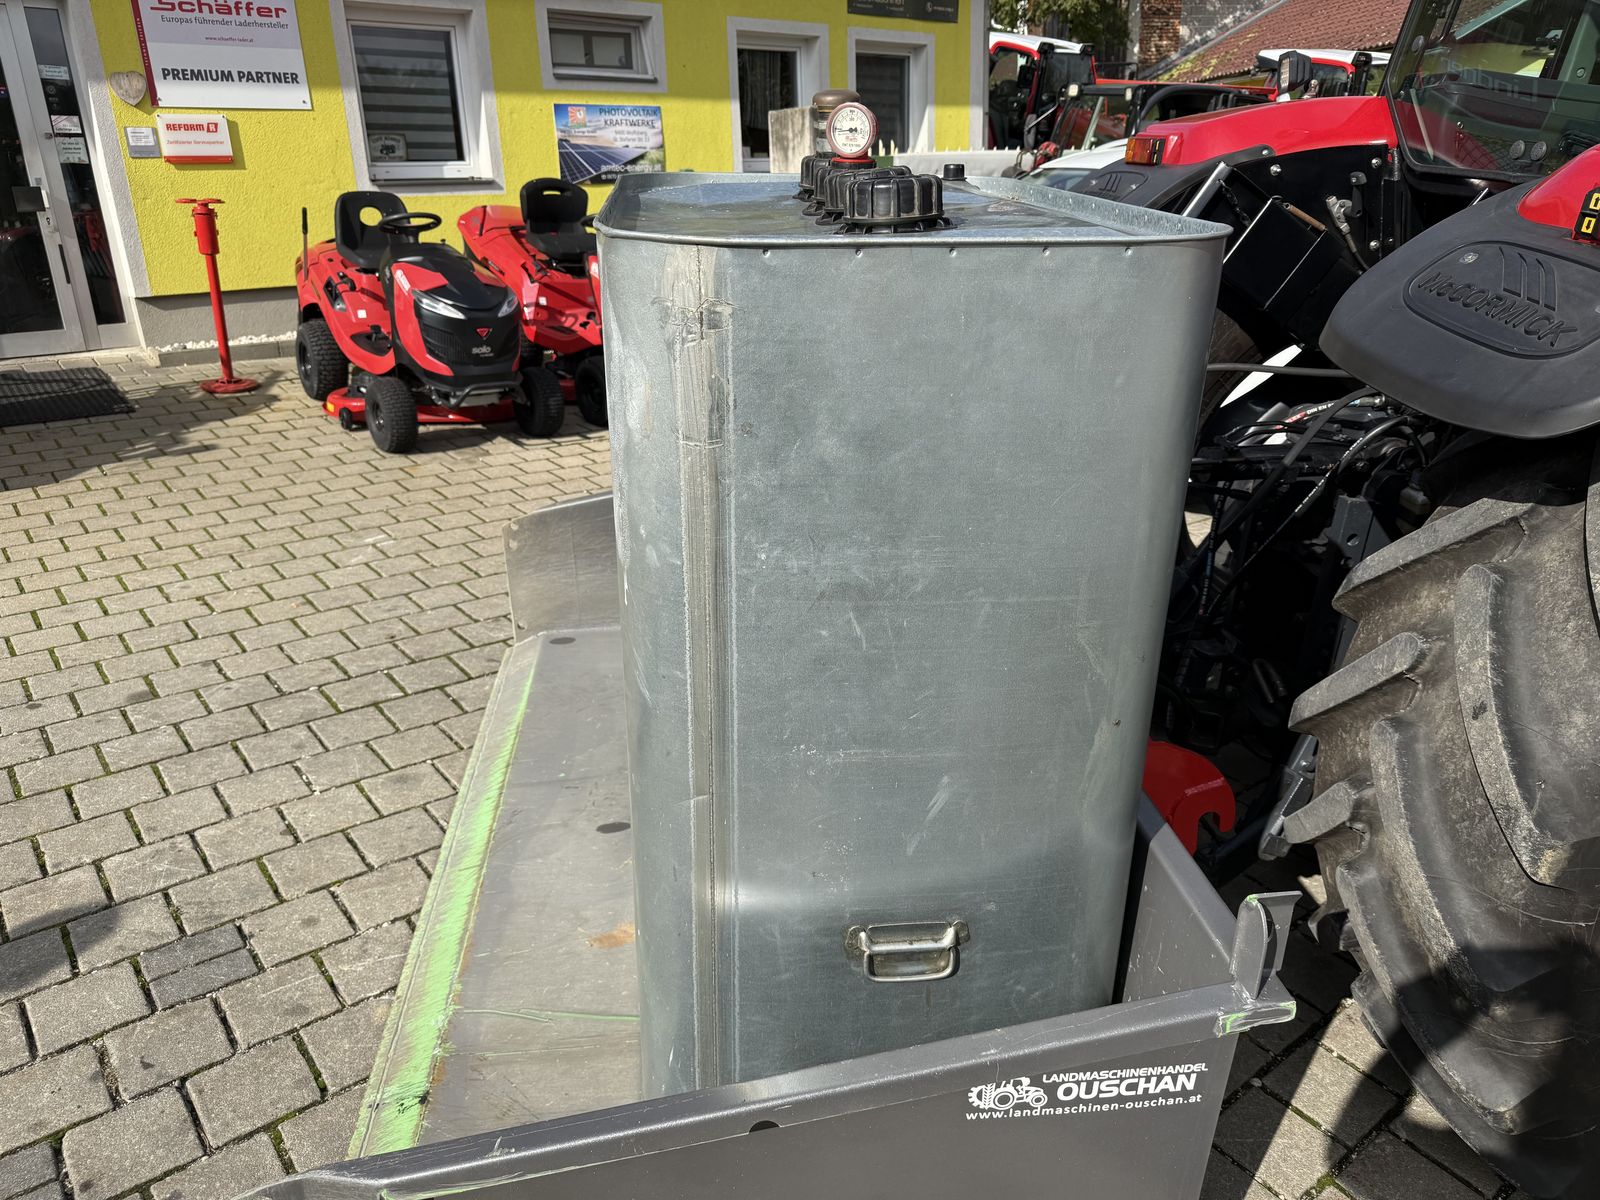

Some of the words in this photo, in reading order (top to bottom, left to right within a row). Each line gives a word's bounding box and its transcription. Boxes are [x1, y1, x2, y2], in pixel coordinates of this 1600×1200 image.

[161, 15, 193, 25] Europas
[194, 17, 233, 27] führender
[234, 20, 289, 30] Laderhersteller
[161, 68, 235, 83] PREMIUM
[237, 70, 300, 85] PARTNER
[599, 107, 658, 117] PHOTOVOLTAIK
[166, 123, 205, 132] REFORM
[604, 119, 656, 128] KRAFTWERKE
[1043, 1063, 1208, 1083] LANDMASCHINENHANDEL
[1057, 1073, 1197, 1101] OUSCHAN
[966, 1094, 1203, 1120] www.landmaschinen-ouschan.at
